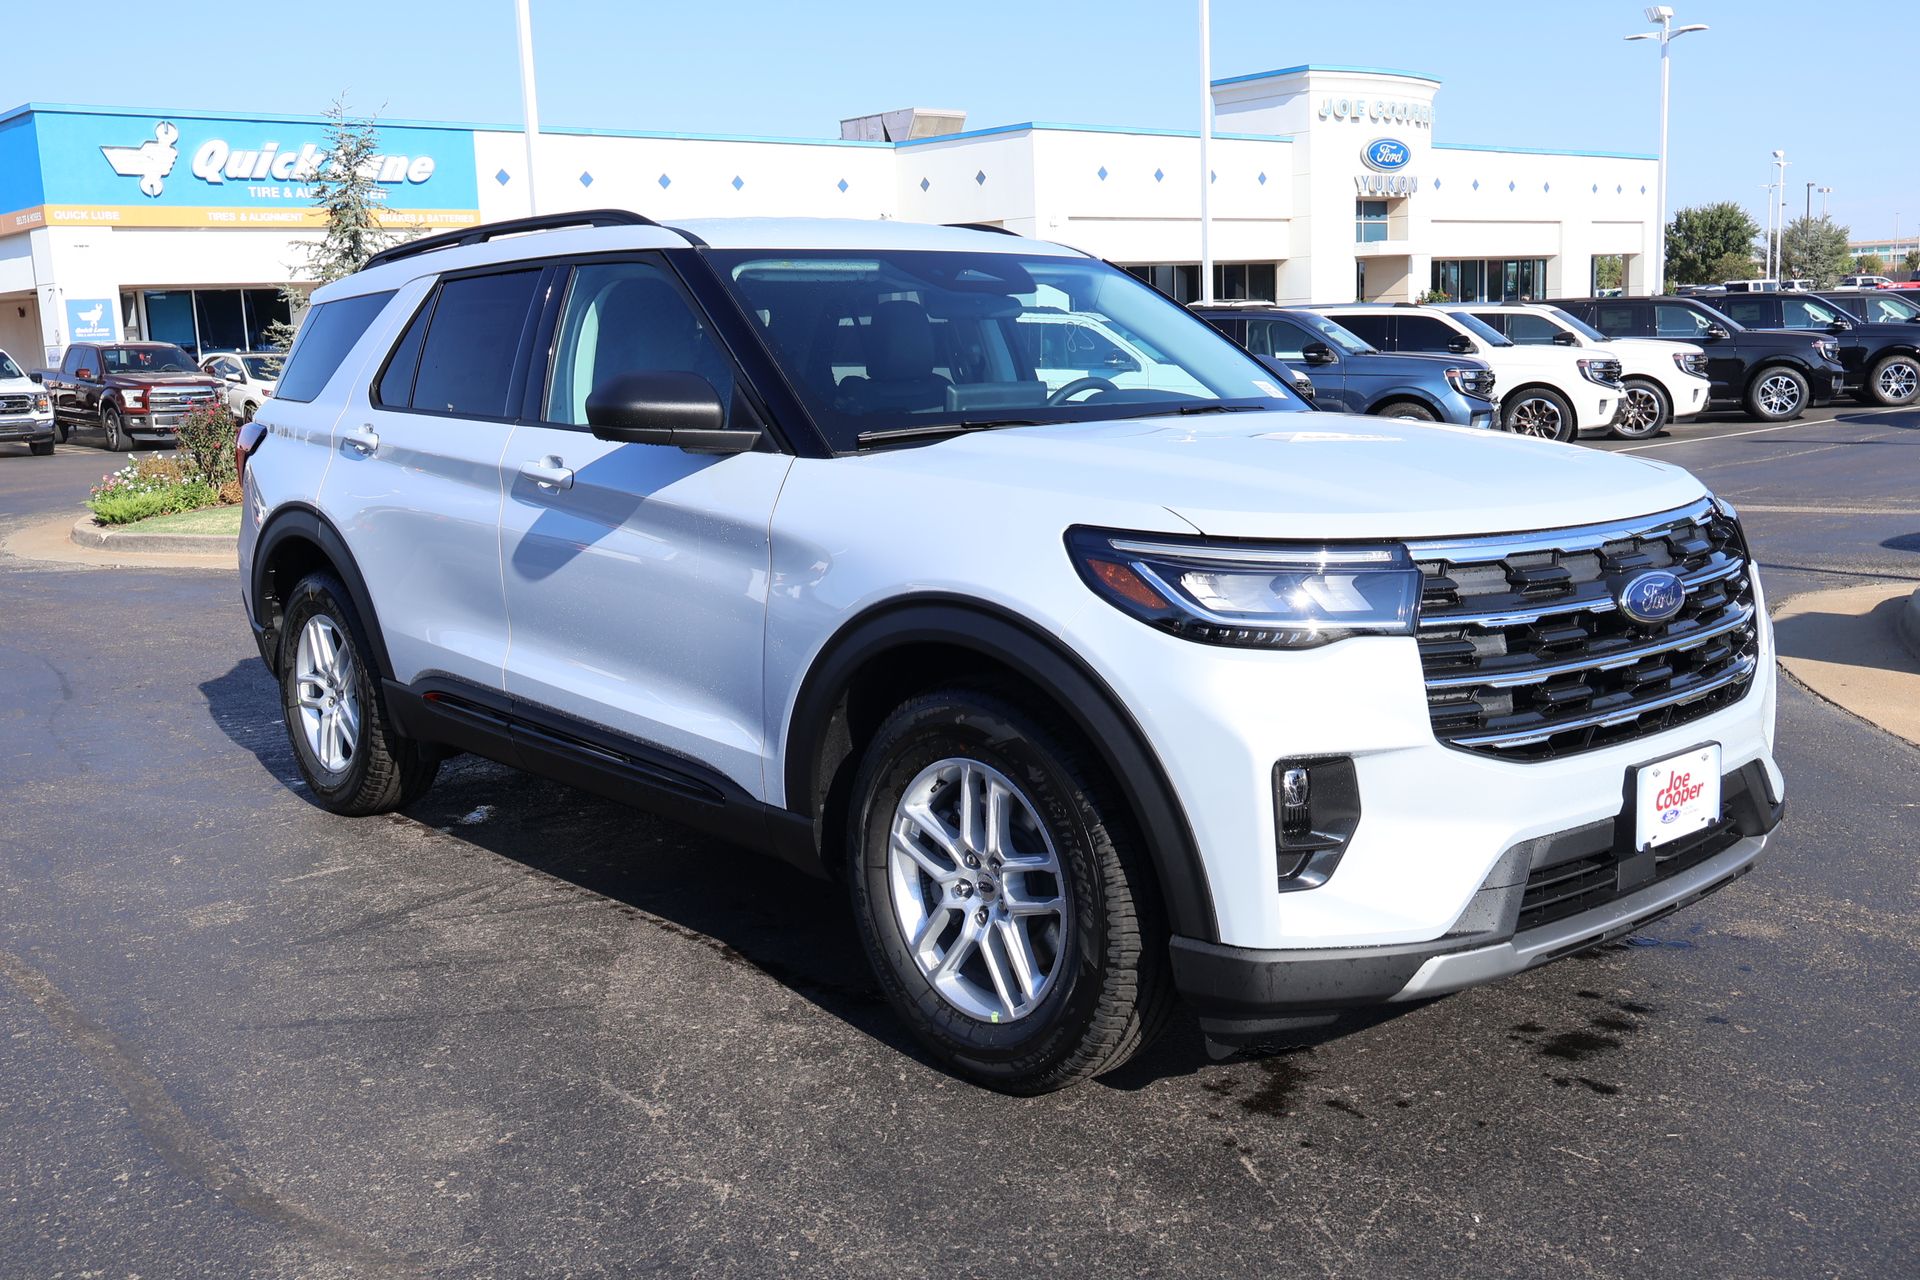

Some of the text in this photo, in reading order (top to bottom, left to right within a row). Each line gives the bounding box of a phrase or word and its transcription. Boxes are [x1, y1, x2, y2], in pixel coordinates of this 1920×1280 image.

[1319, 98, 1366, 121] JOE
[191, 138, 326, 186] Quick
[1376, 143, 1404, 164] Ford
[248, 186, 280, 199] TIRE
[282, 187, 293, 199] &
[296, 187, 331, 200] AU
[1357, 175, 1418, 194] YUKON
[54, 210, 120, 221] QUICK LUBE
[207, 212, 236, 222] TIRES
[240, 212, 247, 222] &
[379, 213, 416, 223] BRAKES
[427, 214, 475, 224] BATTERIES
[1641, 580, 1677, 613] Ford
[1665, 770, 1691, 793] Joe
[1656, 782, 1704, 812] Cooper
